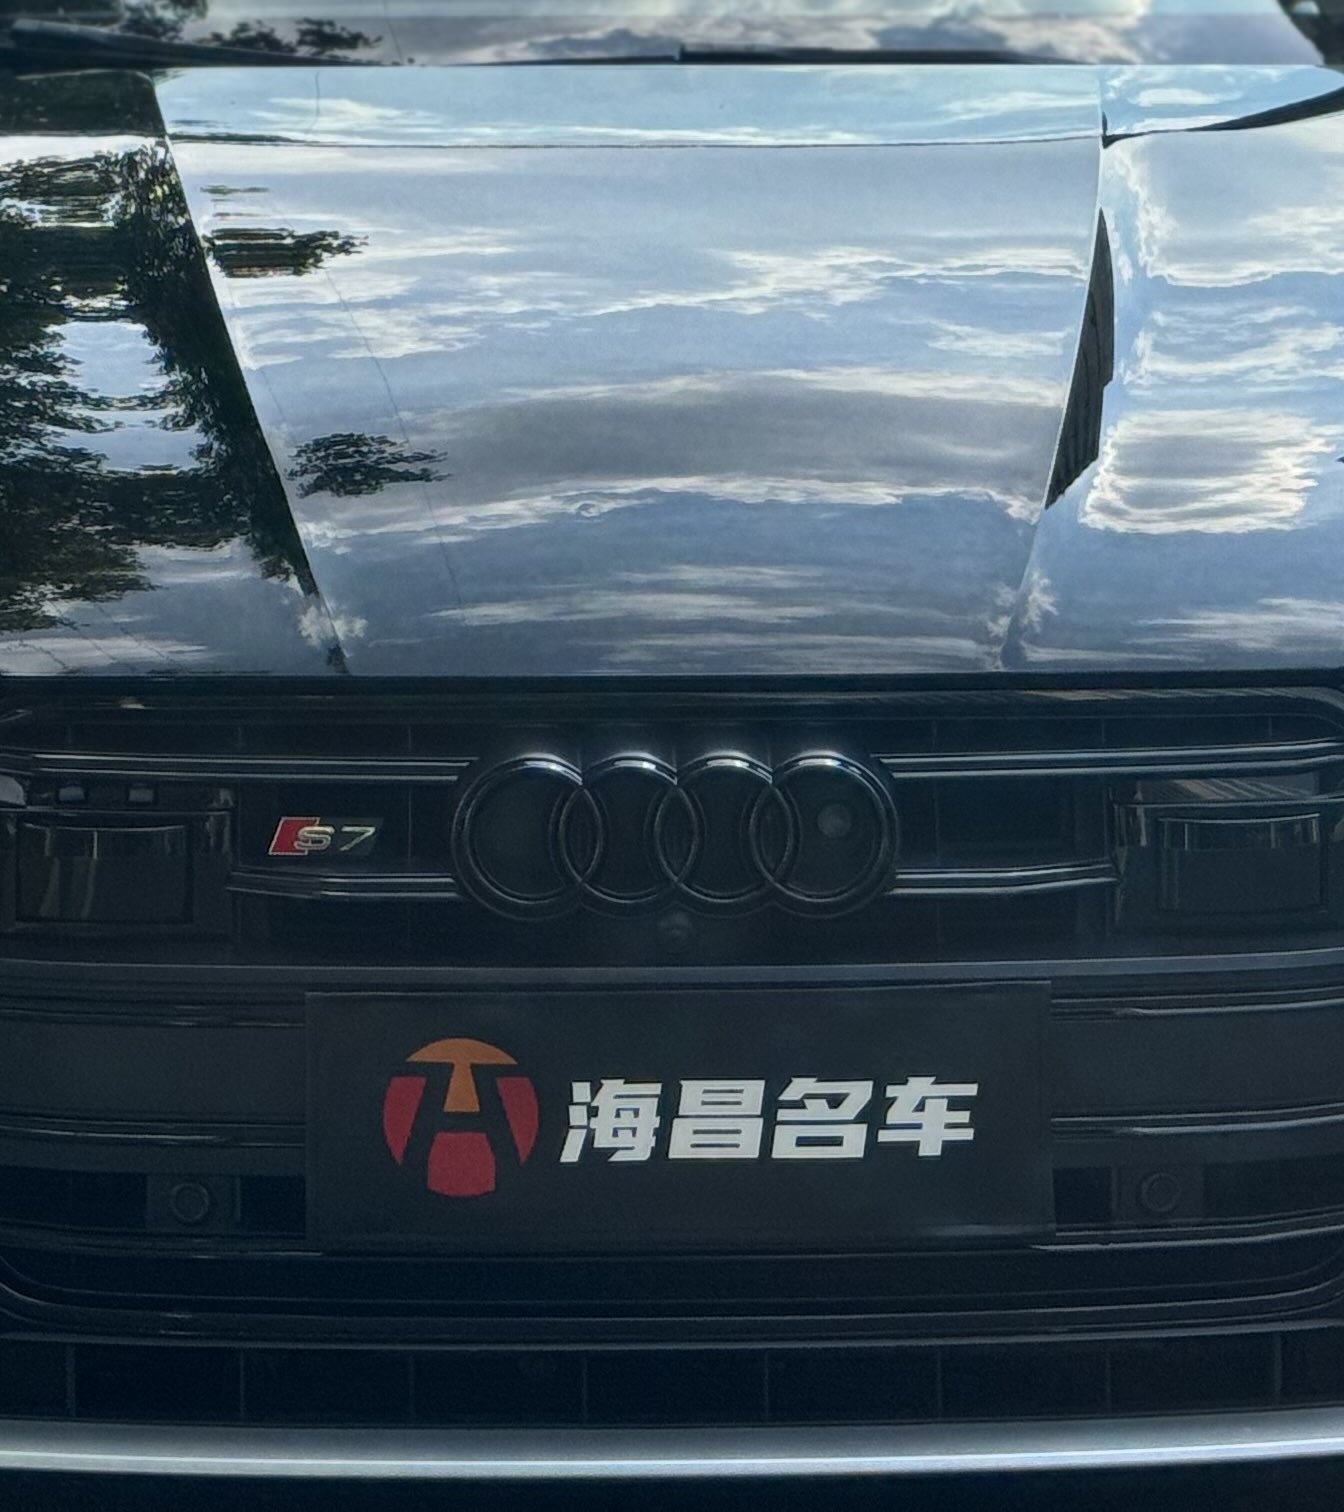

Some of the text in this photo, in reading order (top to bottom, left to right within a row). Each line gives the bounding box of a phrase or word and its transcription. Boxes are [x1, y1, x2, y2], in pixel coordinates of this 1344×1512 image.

[293, 825, 376, 852] S7
[560, 1076, 979, 1163] 海昌名车
